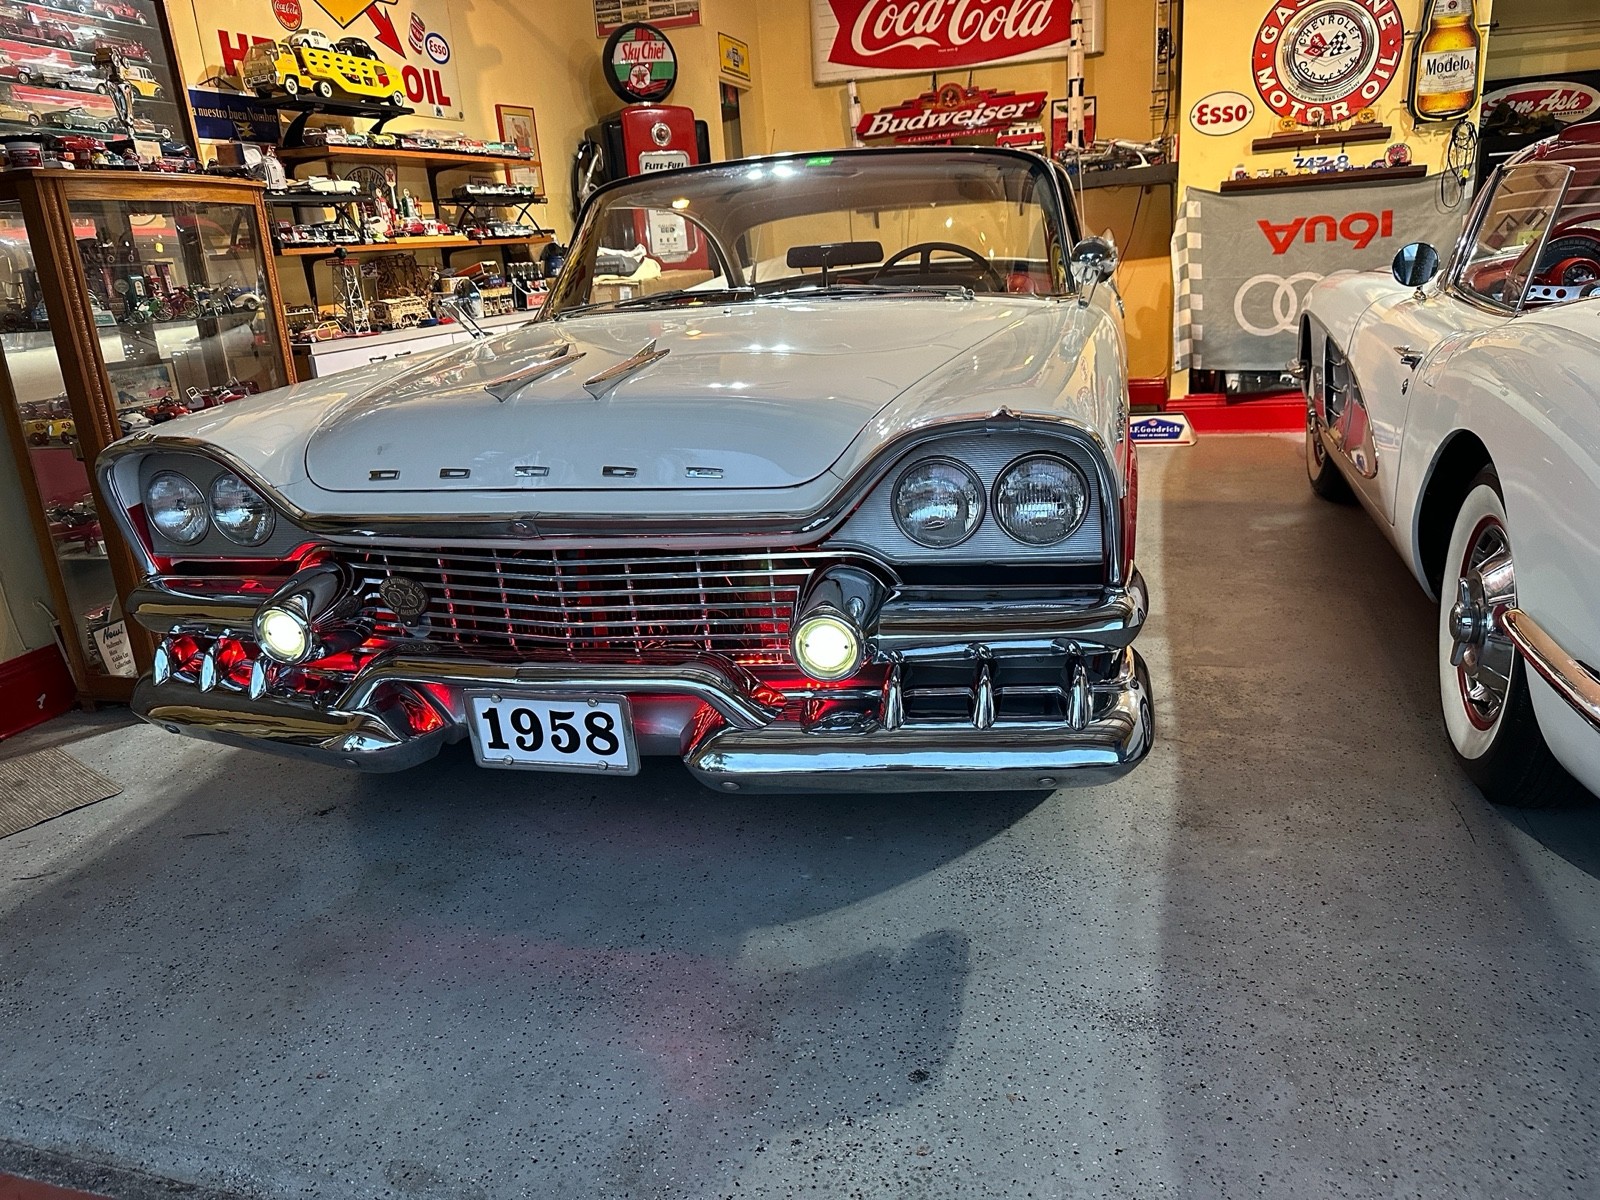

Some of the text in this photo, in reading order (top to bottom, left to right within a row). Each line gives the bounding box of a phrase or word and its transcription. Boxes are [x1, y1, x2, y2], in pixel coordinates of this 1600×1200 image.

[1299, 15, 1360, 46] CHEVROLET
[622, 41, 666, 62] Sky Chief
[1426, 56, 1469, 76] Modelo
[401, 65, 451, 106] OIL
[1257, 50, 1398, 125] MOTOR OIL
[1336, 81, 1361, 99] COMPANY
[1536, 88, 1580, 111] Ash
[198, 107, 228, 118] nuestro
[228, 105, 247, 121] buen
[247, 107, 277, 122] Nombre
[864, 101, 1036, 136] Budweiser
[938, 130, 971, 140] AMERICAN
[61, 421, 71, 430] 49
[103, 623, 123, 644] New!
[481, 707, 619, 756] 1958
